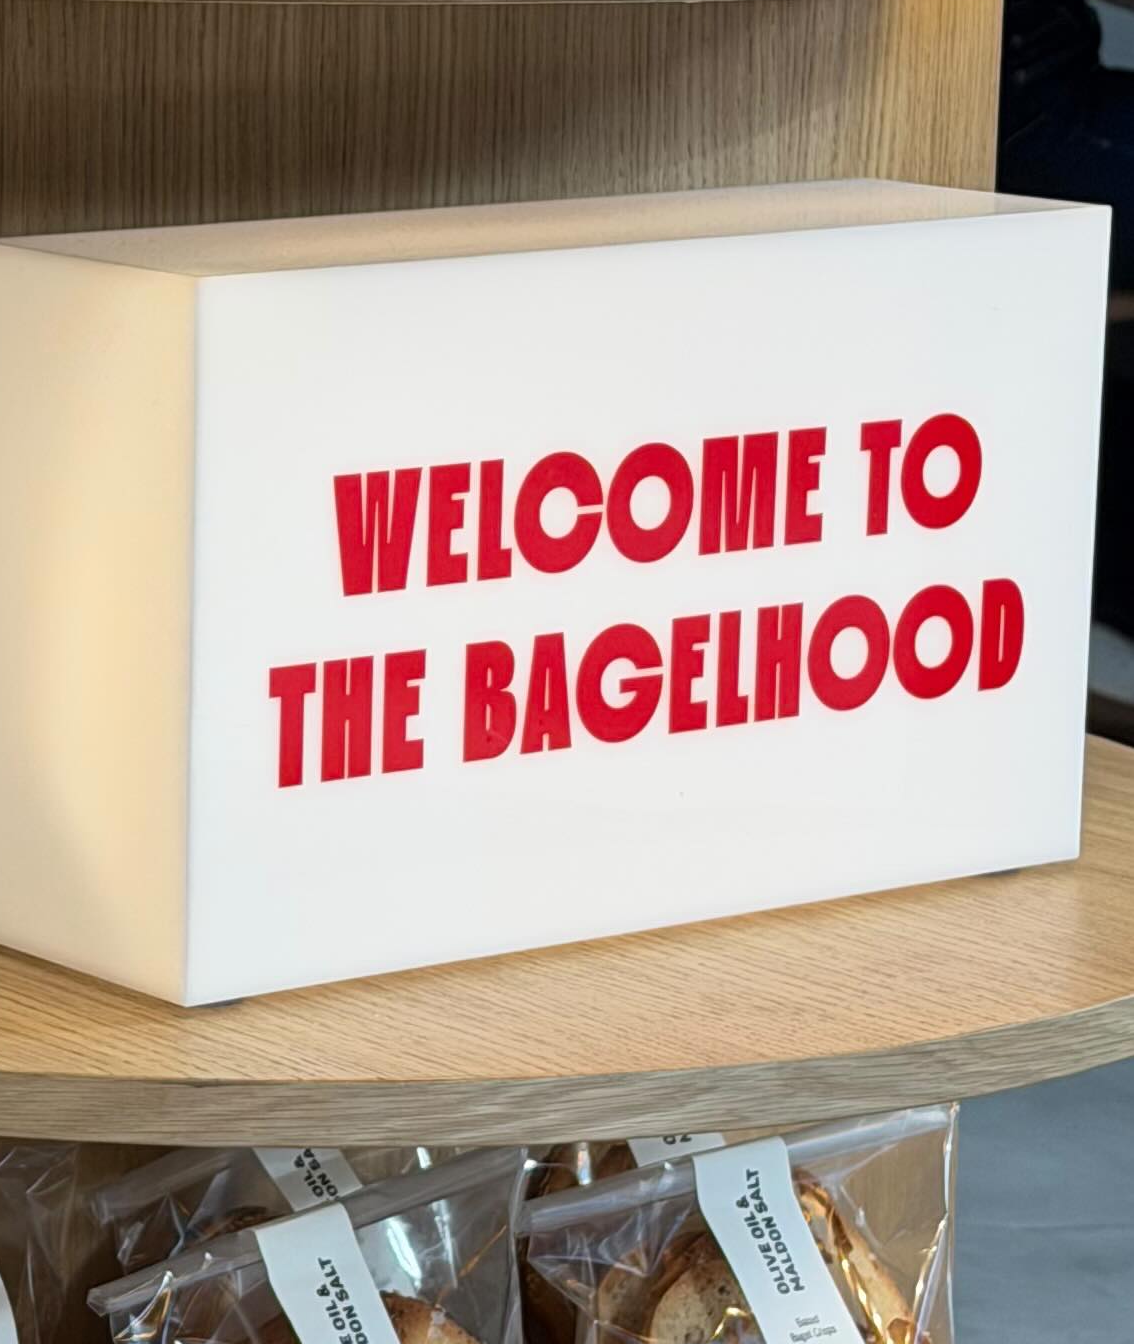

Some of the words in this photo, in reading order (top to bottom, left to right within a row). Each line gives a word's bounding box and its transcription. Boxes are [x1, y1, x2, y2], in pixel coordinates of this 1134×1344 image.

[333, 426, 827, 597] WELCOME
[860, 413, 983, 536] TO
[269, 649, 427, 788] THE
[463, 578, 1025, 763] BAGELHOOD
[304, 1169, 324, 1198] OIL
[317, 1172, 338, 1200] ON
[736, 1194, 750, 1209] &
[746, 1168, 768, 1213] SALT
[744, 1210, 765, 1239] OIL
[758, 1242, 790, 1294] OLIVE
[761, 1216, 805, 1291] MALDON
[316, 1283, 330, 1297] &
[318, 1257, 350, 1302] SALT
[325, 1300, 346, 1331] OIL
